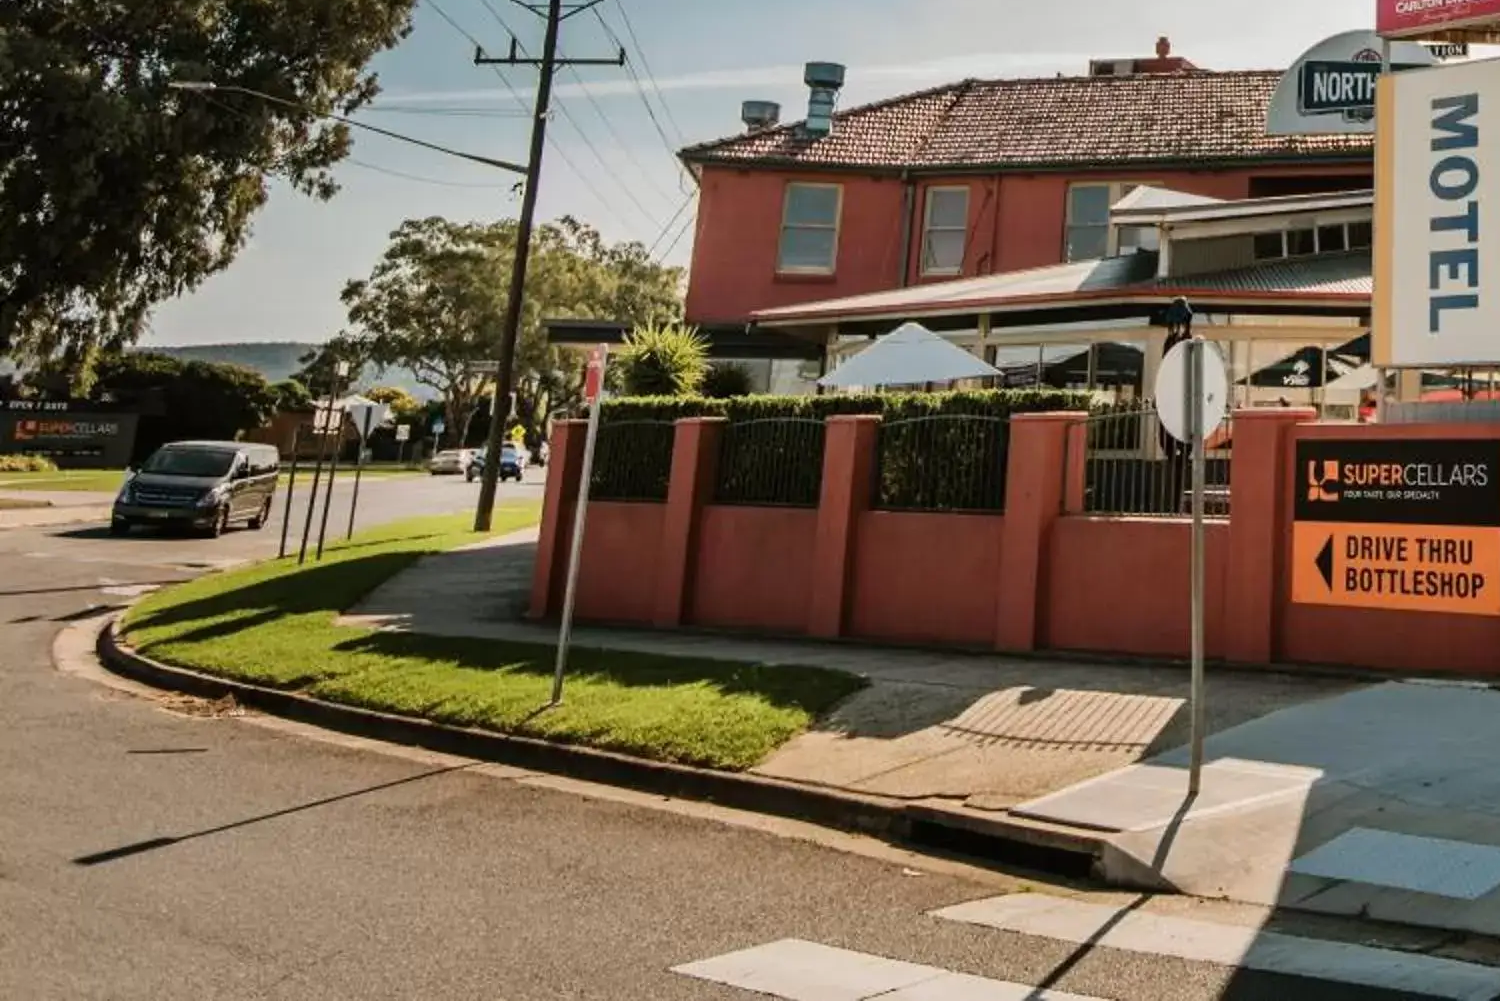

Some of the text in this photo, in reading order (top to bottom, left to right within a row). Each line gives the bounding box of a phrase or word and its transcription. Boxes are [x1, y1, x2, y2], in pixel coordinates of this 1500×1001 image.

[1429, 93, 1479, 333] MOTEL
[1344, 463, 1488, 486] SUPERCELLARS
[1346, 535, 1473, 564] DRIVE THRU
[1345, 567, 1485, 598] BOTTLESHOP
